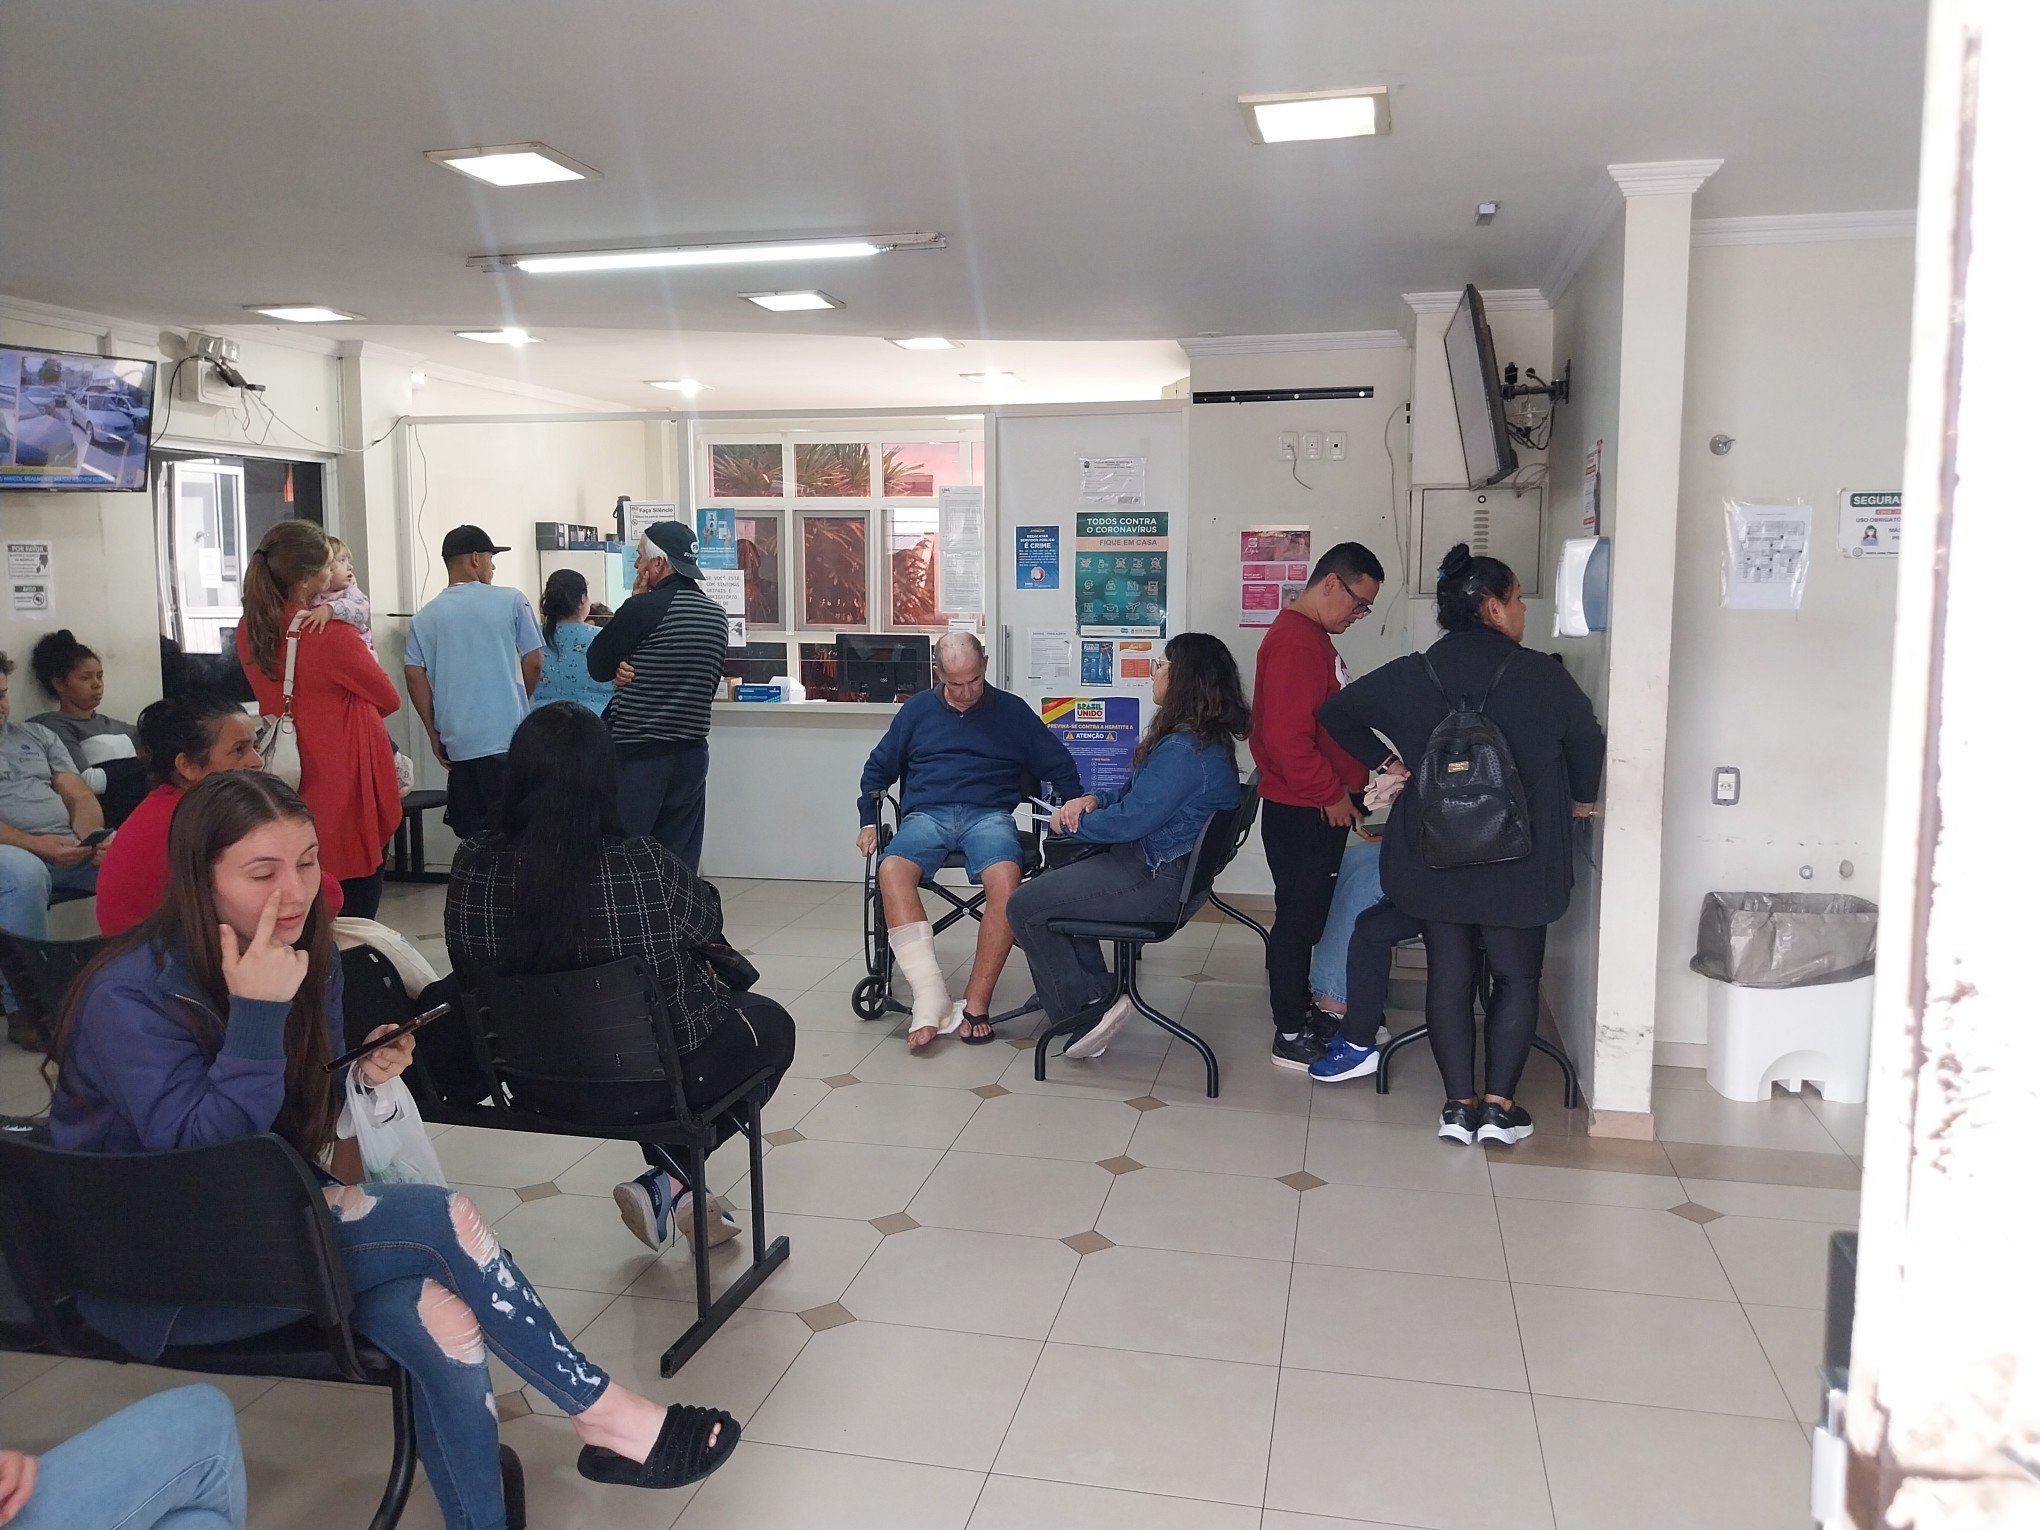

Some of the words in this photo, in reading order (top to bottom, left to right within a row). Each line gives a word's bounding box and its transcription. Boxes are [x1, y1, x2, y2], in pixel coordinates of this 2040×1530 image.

[1853, 496, 1901, 505] SEGURA
[1095, 525, 1157, 533] CORONAVÍRUS
[1024, 541, 1029, 549] É
[1075, 732, 1104, 740] ATENÇÃO
